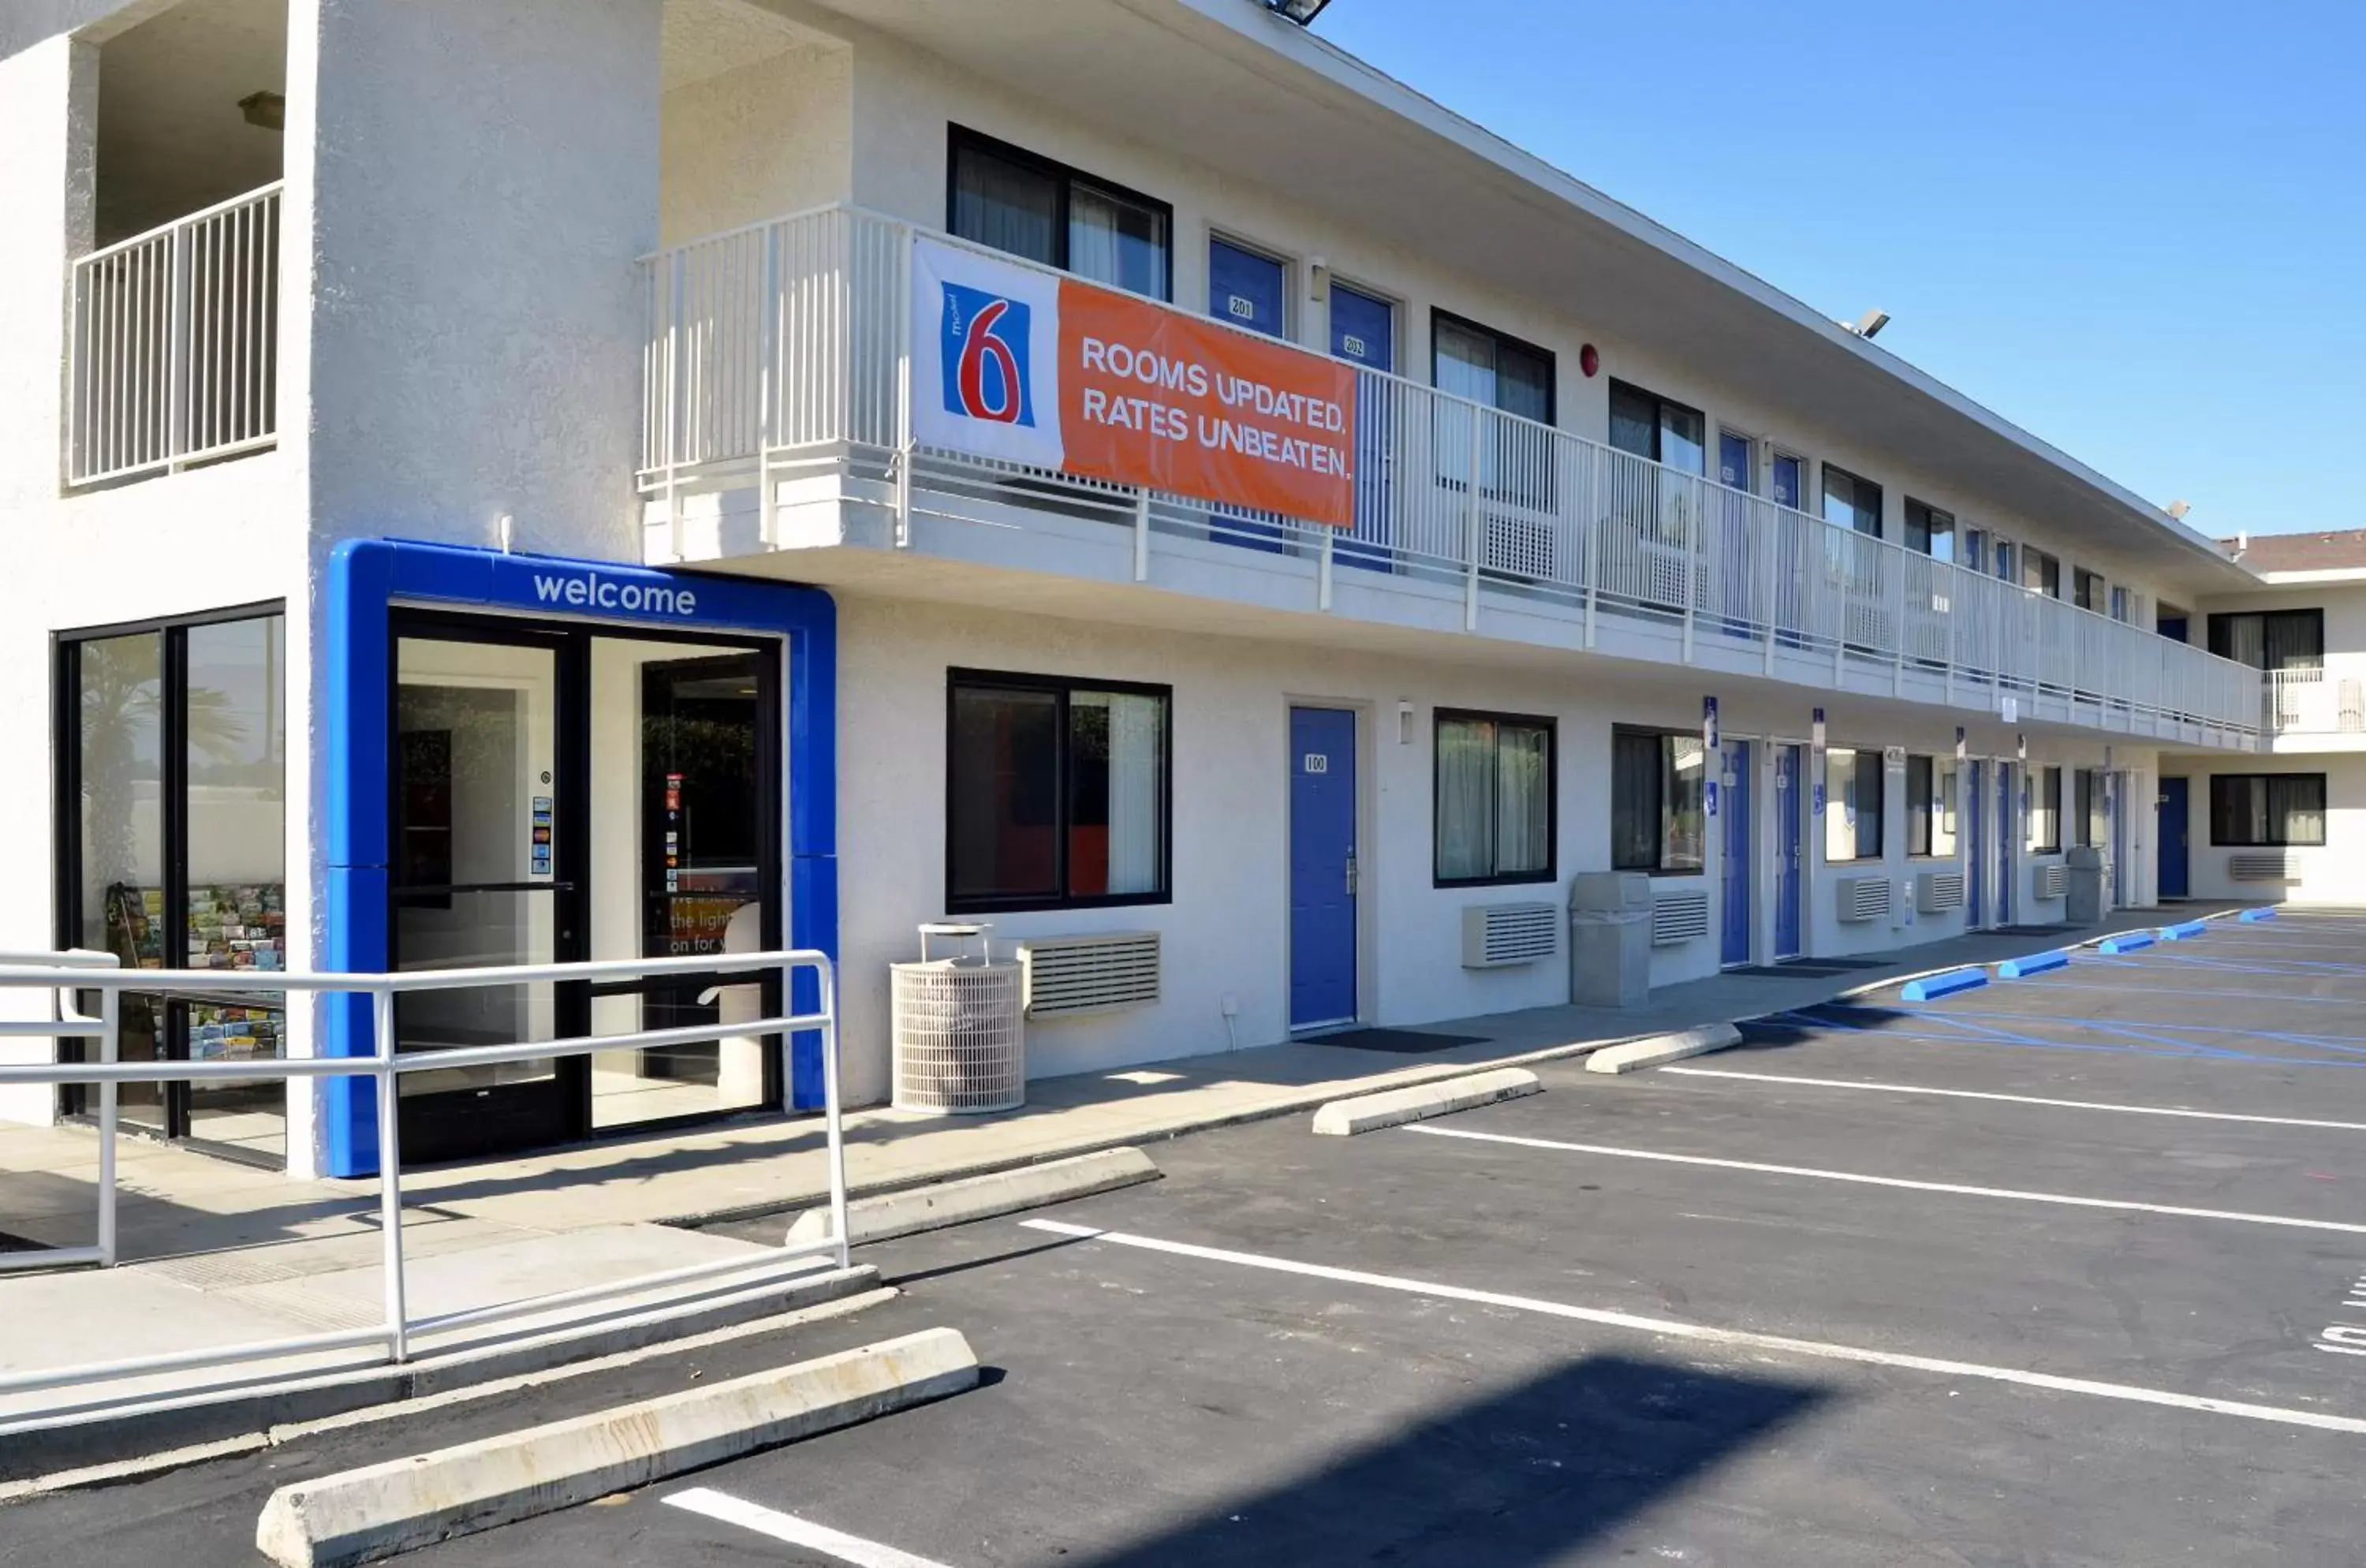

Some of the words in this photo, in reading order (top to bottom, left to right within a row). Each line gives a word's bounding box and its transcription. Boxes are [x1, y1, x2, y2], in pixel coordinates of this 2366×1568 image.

[1232, 299, 1252, 316] 201
[957, 298, 1021, 425] 6
[1082, 337, 1208, 398] ROOMS
[1215, 372, 1346, 435] UPDATED.
[1084, 387, 1189, 441] RATES
[1197, 415, 1352, 480] UNBEATEN.
[533, 572, 697, 615] welcome
[1308, 756, 1324, 771] 100
[670, 910, 694, 929] the
[670, 940, 689, 953] on
[695, 934, 715, 952] for
